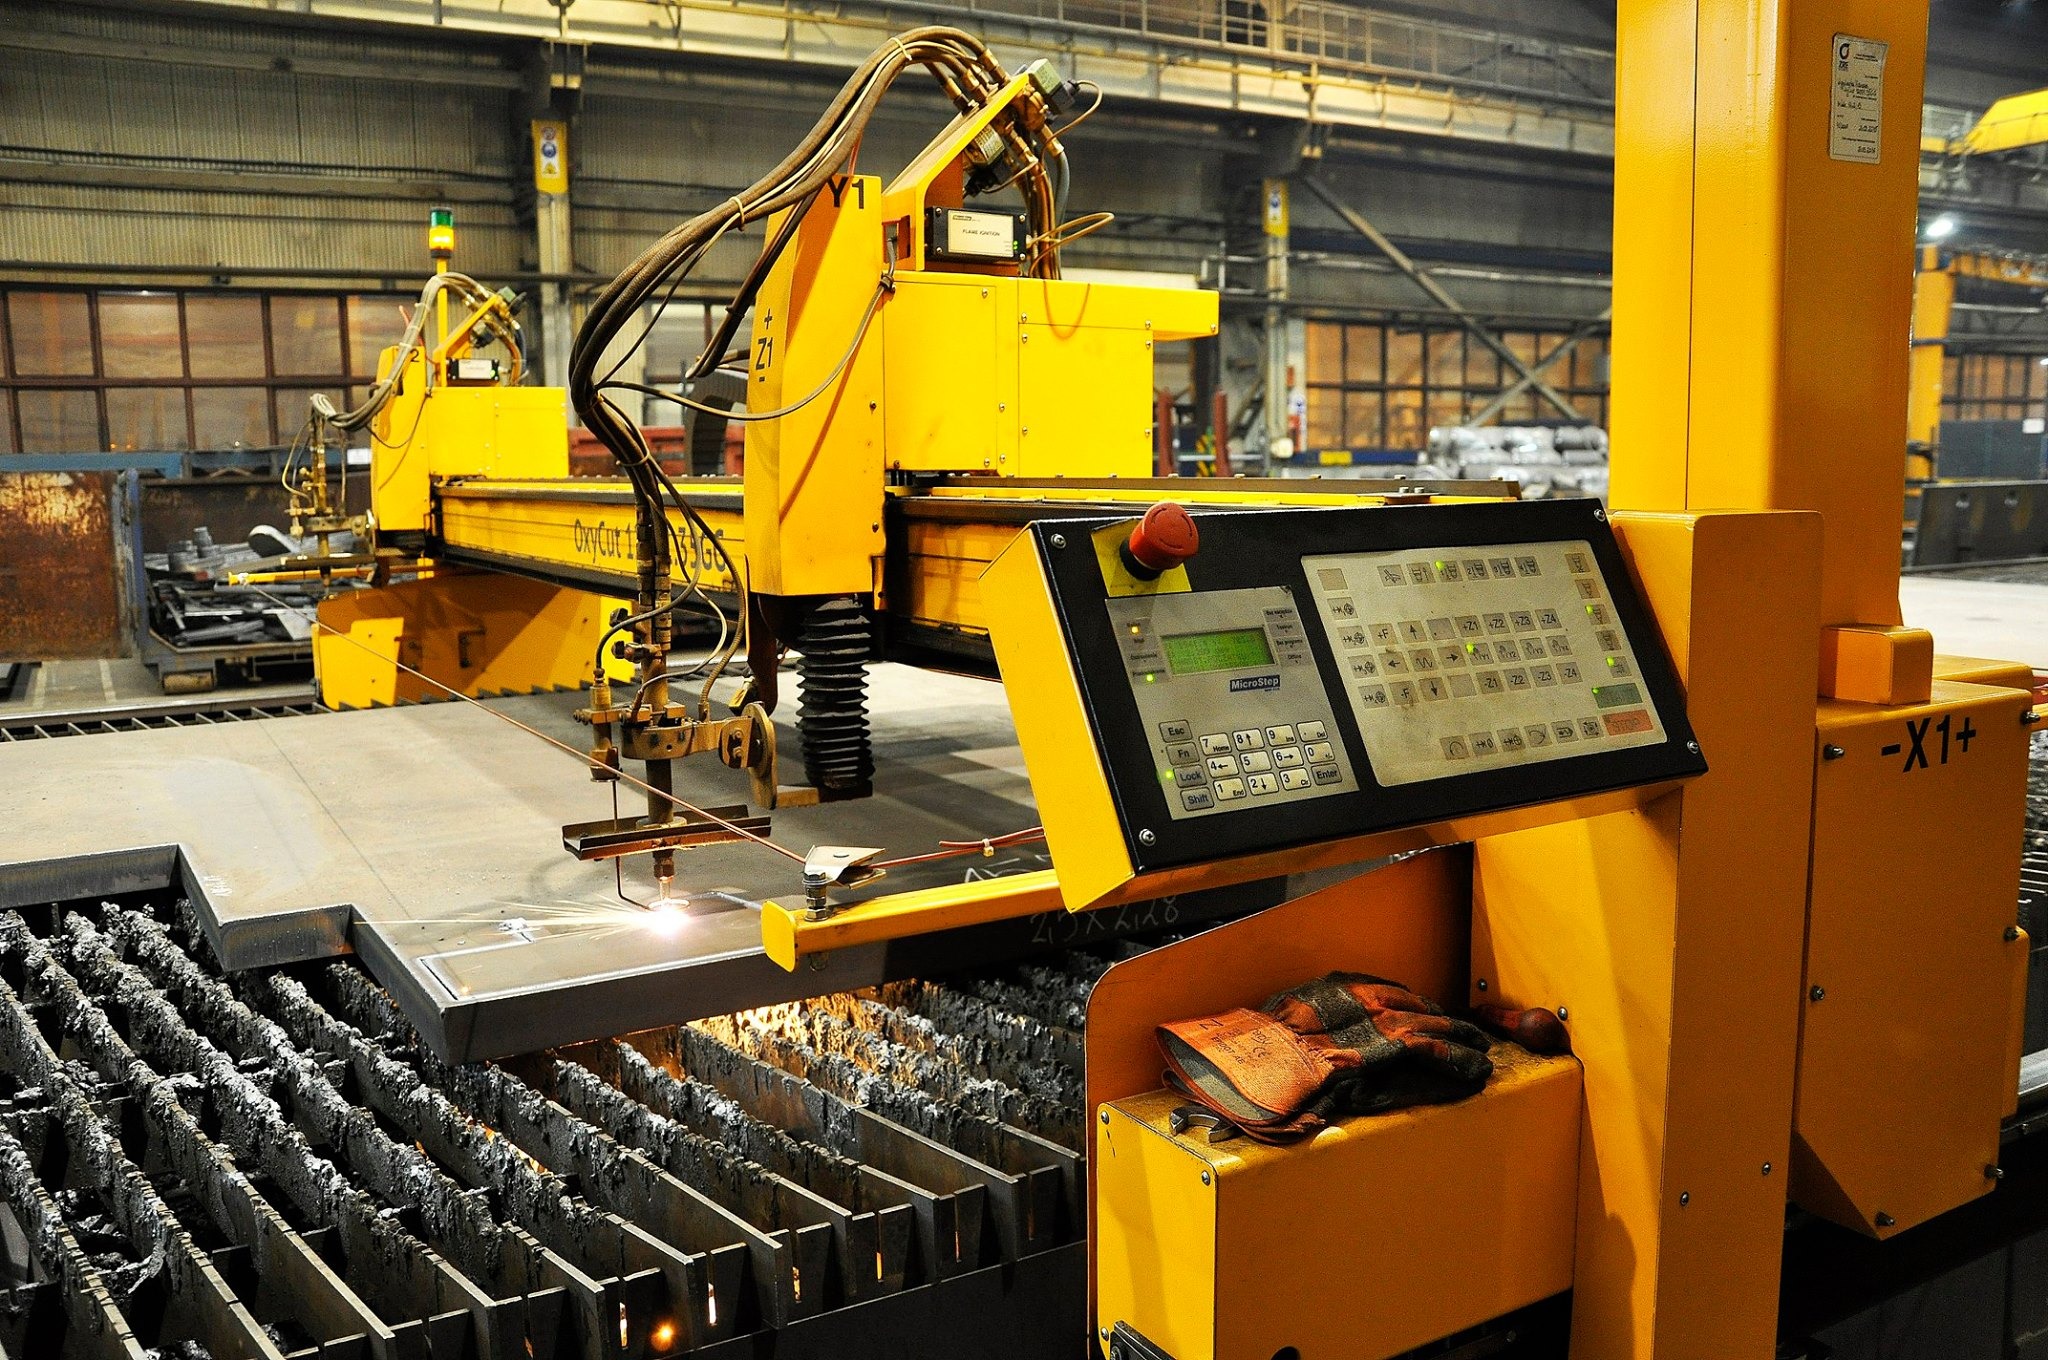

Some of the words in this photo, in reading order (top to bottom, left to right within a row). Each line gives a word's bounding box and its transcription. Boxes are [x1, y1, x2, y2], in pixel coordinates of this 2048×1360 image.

[827, 176, 865, 209] Y1
[755, 337, 773, 371] Z1
[574, 518, 622, 564] OxyCut
[1488, 619, 1505, 629] +Z2
[1514, 616, 1531, 626] +Z3
[1231, 677, 1279, 691] MicroStep
[1168, 727, 1185, 735] Esc
[1269, 731, 1276, 740] 9
[1202, 739, 1209, 748] 7
[1236, 735, 1243, 744] 8
[1178, 749, 1189, 758] Fn
[1276, 752, 1282, 761] 6
[1307, 748, 1314, 757] 0
[1210, 761, 1217, 770] 4
[1243, 757, 1250, 766] 5
[1180, 771, 1202, 781] Lock
[1283, 774, 1290, 783] 3
[1316, 770, 1338, 780] Enter
[1250, 778, 1258, 788] 2
[1217, 784, 1224, 793] 1
[1187, 795, 1209, 804] Shift
